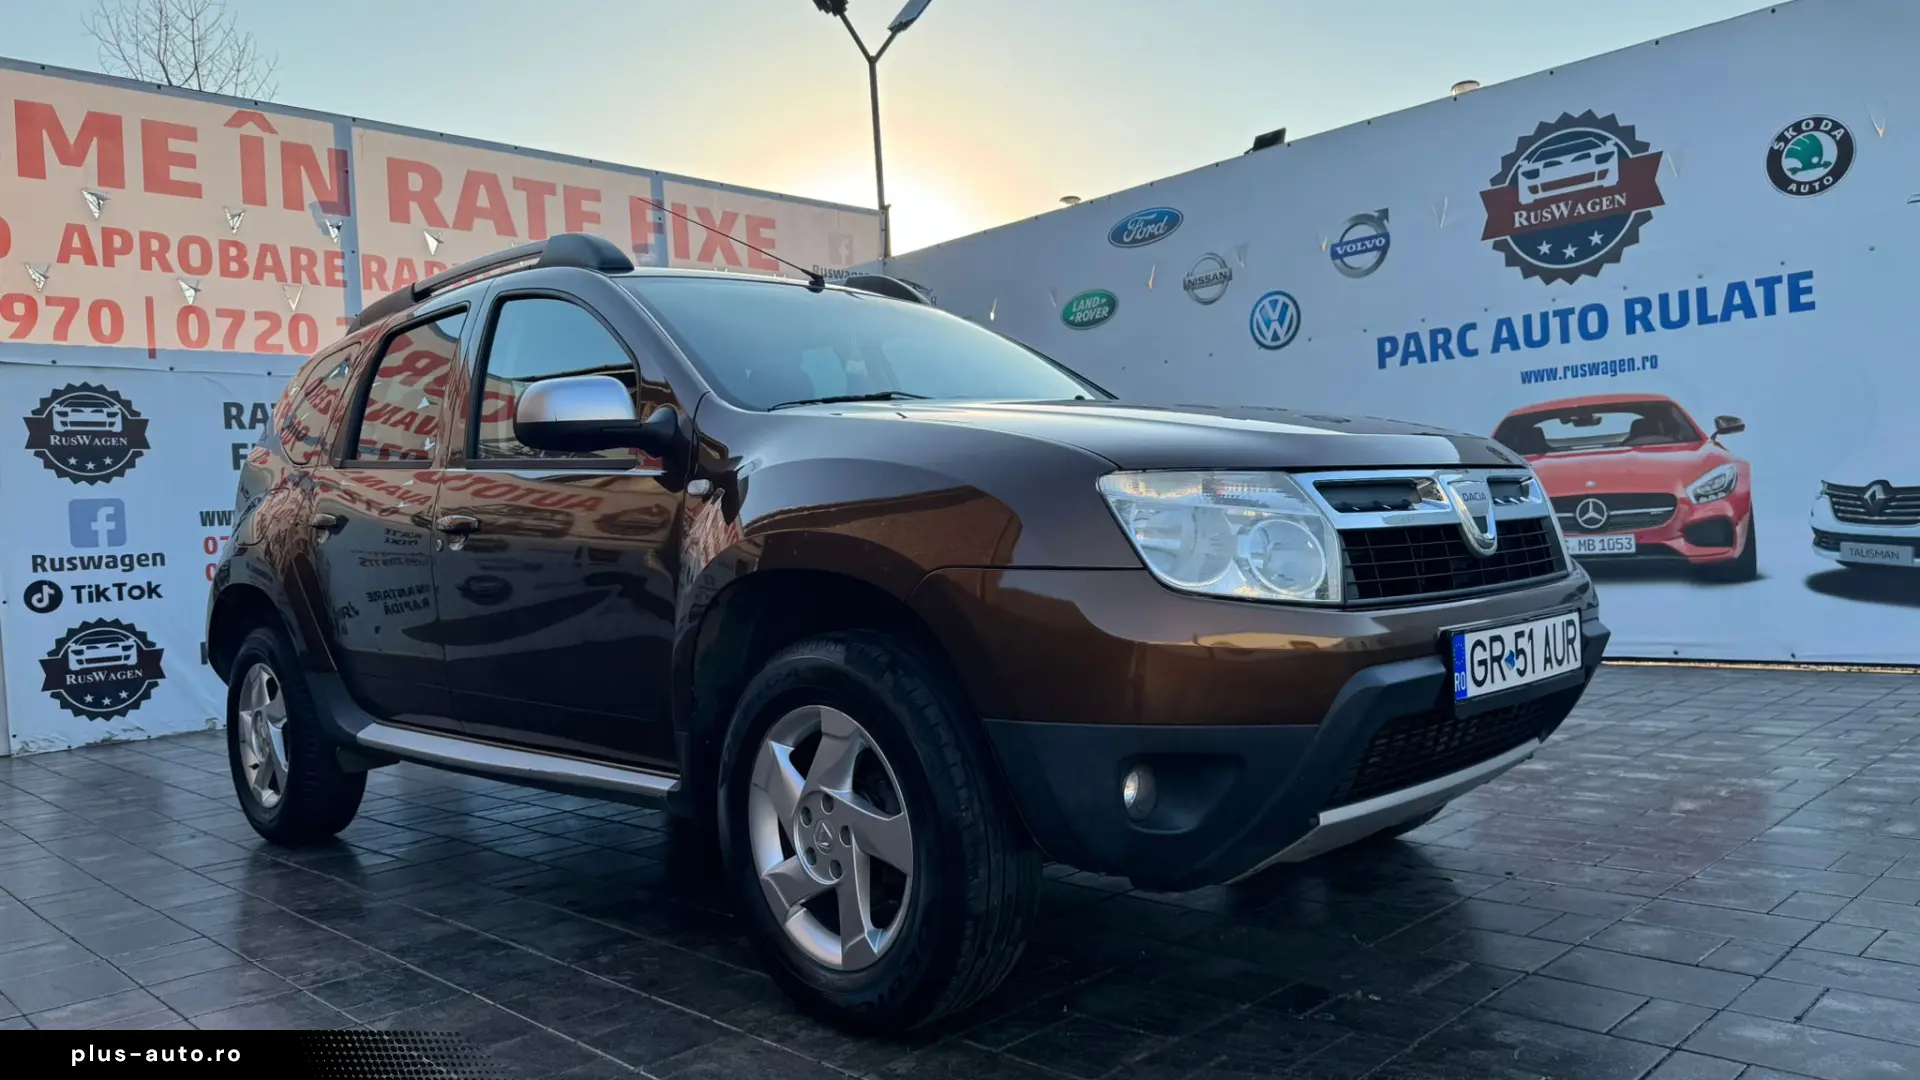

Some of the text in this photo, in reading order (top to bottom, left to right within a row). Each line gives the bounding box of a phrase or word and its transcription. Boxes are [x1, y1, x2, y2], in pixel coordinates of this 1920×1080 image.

[1773, 119, 1845, 151] SKODA
[14, 99, 203, 199] ME
[224, 109, 351, 217] ÎN
[629, 195, 780, 272] FIXE
[1787, 176, 1834, 193] AUTO
[1123, 213, 1168, 243] Ford
[56, 222, 348, 289] APROBARE
[1336, 237, 1386, 255] VOLVO
[1187, 271, 1229, 288] NISSAN
[1072, 296, 1100, 313] LAND
[1075, 305, 1110, 323] ROVER
[176, 304, 319, 355] 0720
[1376, 269, 1816, 369] PARC AUTO RULATE
[1520, 353, 1659, 384] www.ruswagen.ro
[1462, 492, 1488, 502] DACIA
[1598, 537, 1634, 552] 1053
[1849, 547, 1901, 562] TALISMAN
[32, 551, 166, 573] Ruswagen
[71, 581, 164, 605] TikTok
[1470, 618, 1579, 689] GR 51 AUR
[1454, 671, 1467, 693] RO
